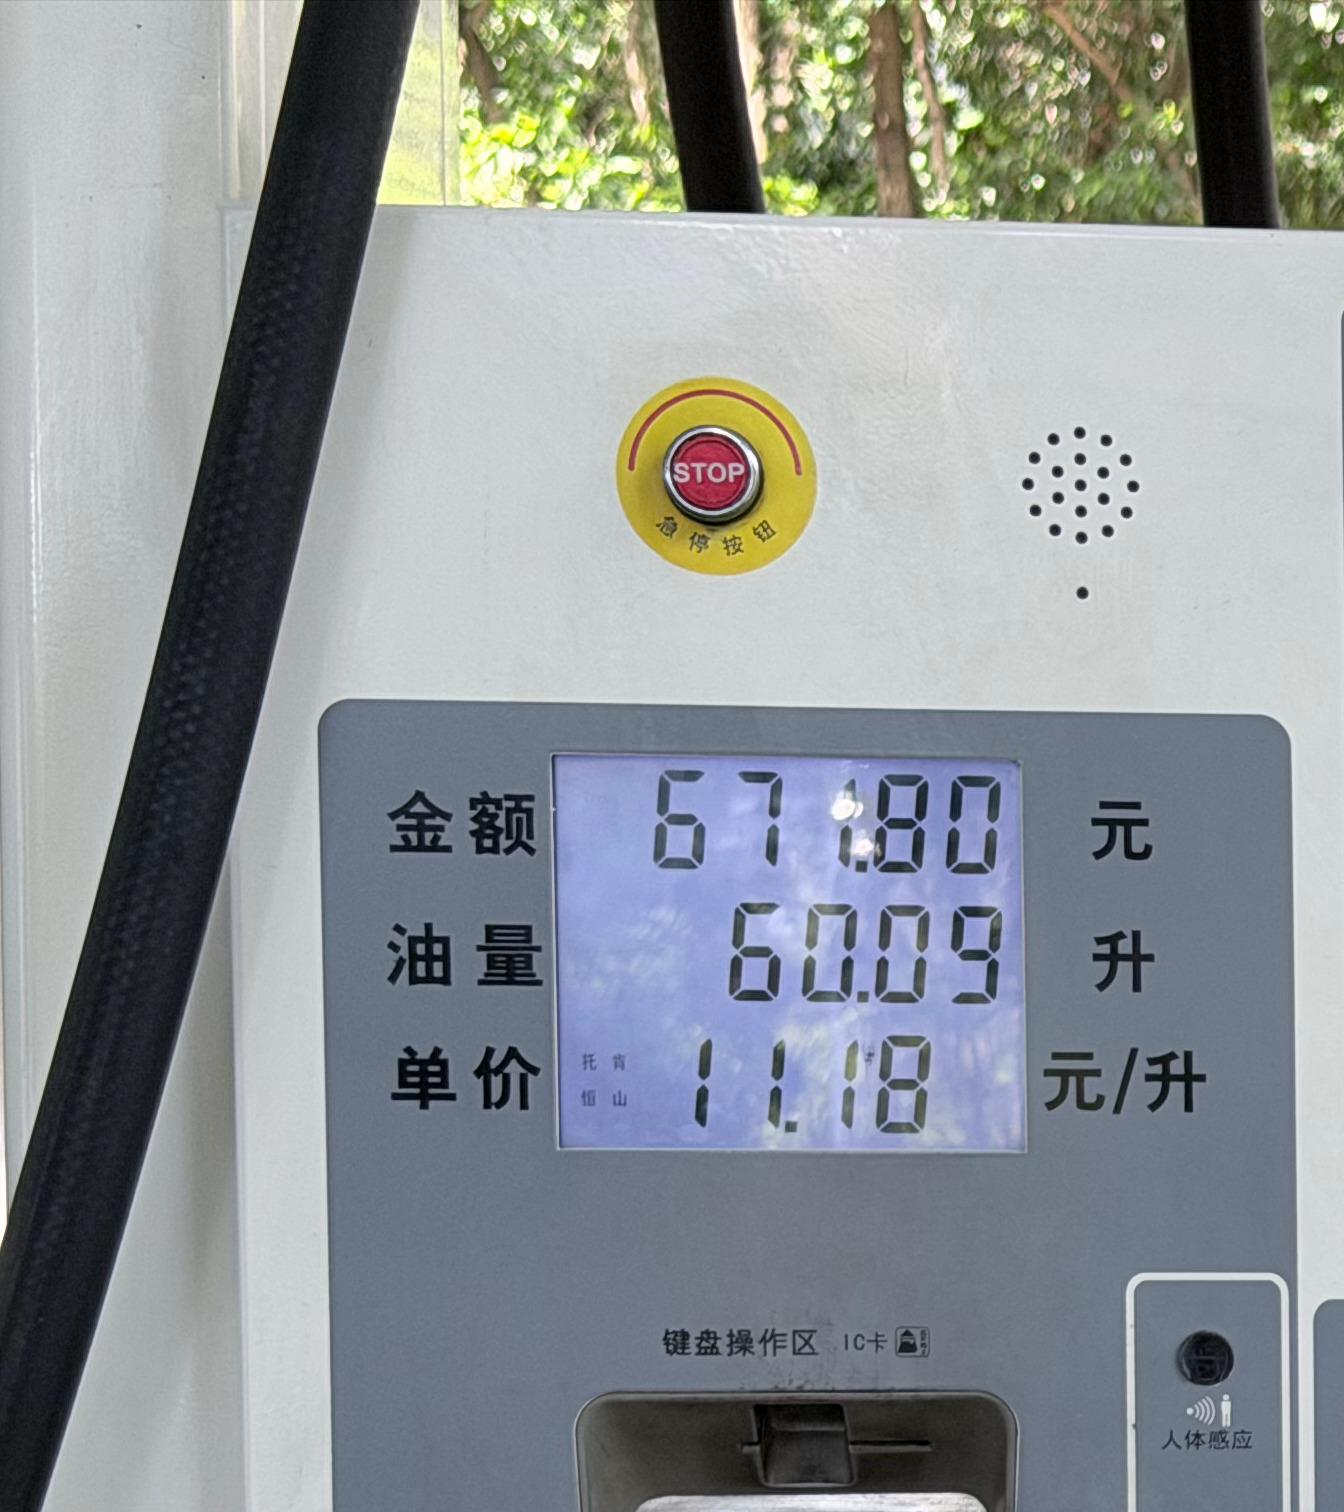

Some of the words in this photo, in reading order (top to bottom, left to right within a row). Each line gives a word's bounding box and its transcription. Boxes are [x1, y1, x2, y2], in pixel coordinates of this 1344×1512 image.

[673, 462, 745, 483] STOP
[656, 516, 776, 556] 急停按钮
[387, 790, 537, 857] 金额
[653, 769, 1001, 874] 671.80
[1091, 801, 1153, 861] 元
[387, 923, 543, 986] 油量
[728, 902, 1003, 1004] 60.09
[1092, 930, 1155, 992] 升
[391, 1045, 541, 1111] 单价
[694, 1035, 931, 1133] 11.18
[1044, 1047, 1207, 1114] 元/升
[662, 1328, 819, 1356] 键盘操作区
[844, 1331, 888, 1354] IC卡
[1161, 1429, 1253, 1451] 人体感应
